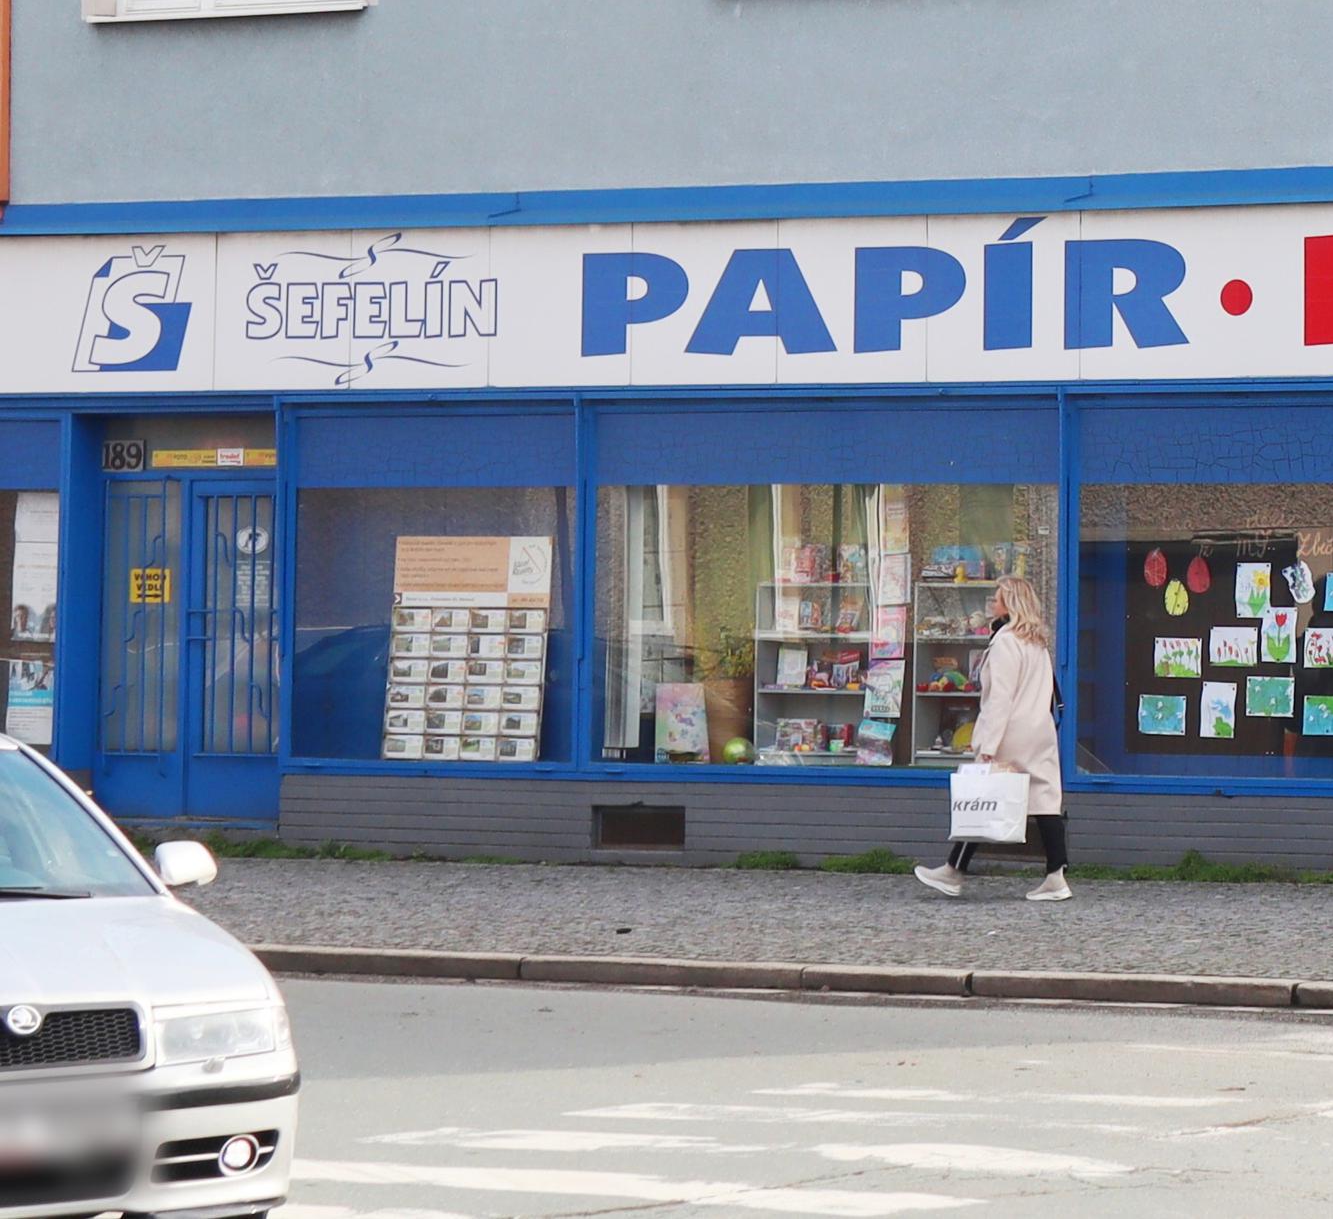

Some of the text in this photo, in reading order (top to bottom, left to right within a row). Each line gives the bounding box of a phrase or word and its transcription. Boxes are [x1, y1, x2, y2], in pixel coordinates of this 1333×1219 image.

[244, 261, 498, 340] ŠEFELÍN
[581, 215, 1190, 357] PAPÍR
[102, 442, 143, 470] 189
